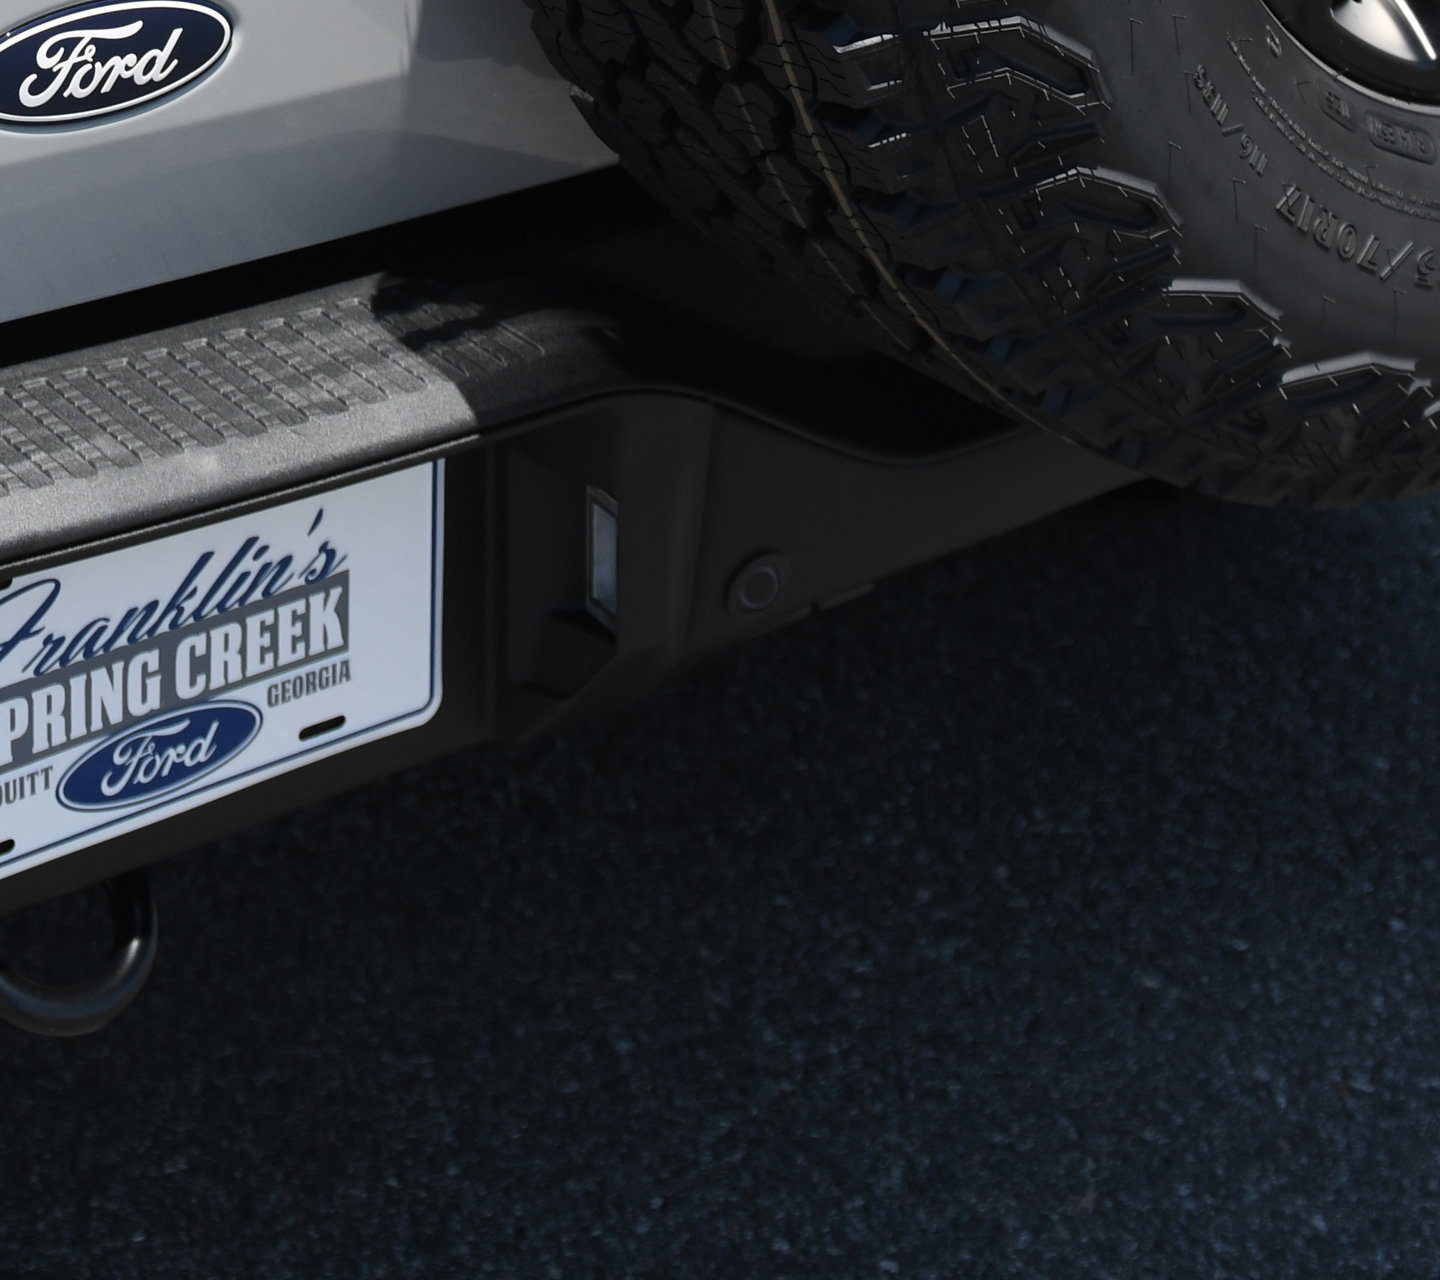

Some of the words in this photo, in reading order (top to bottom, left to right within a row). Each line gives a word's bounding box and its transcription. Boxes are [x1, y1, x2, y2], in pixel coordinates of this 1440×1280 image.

[18, 19, 184, 108] Ford
[175, 586, 346, 701] CREEK
[266, 660, 351, 709] GEORGIA
[100, 721, 221, 797] Ford
